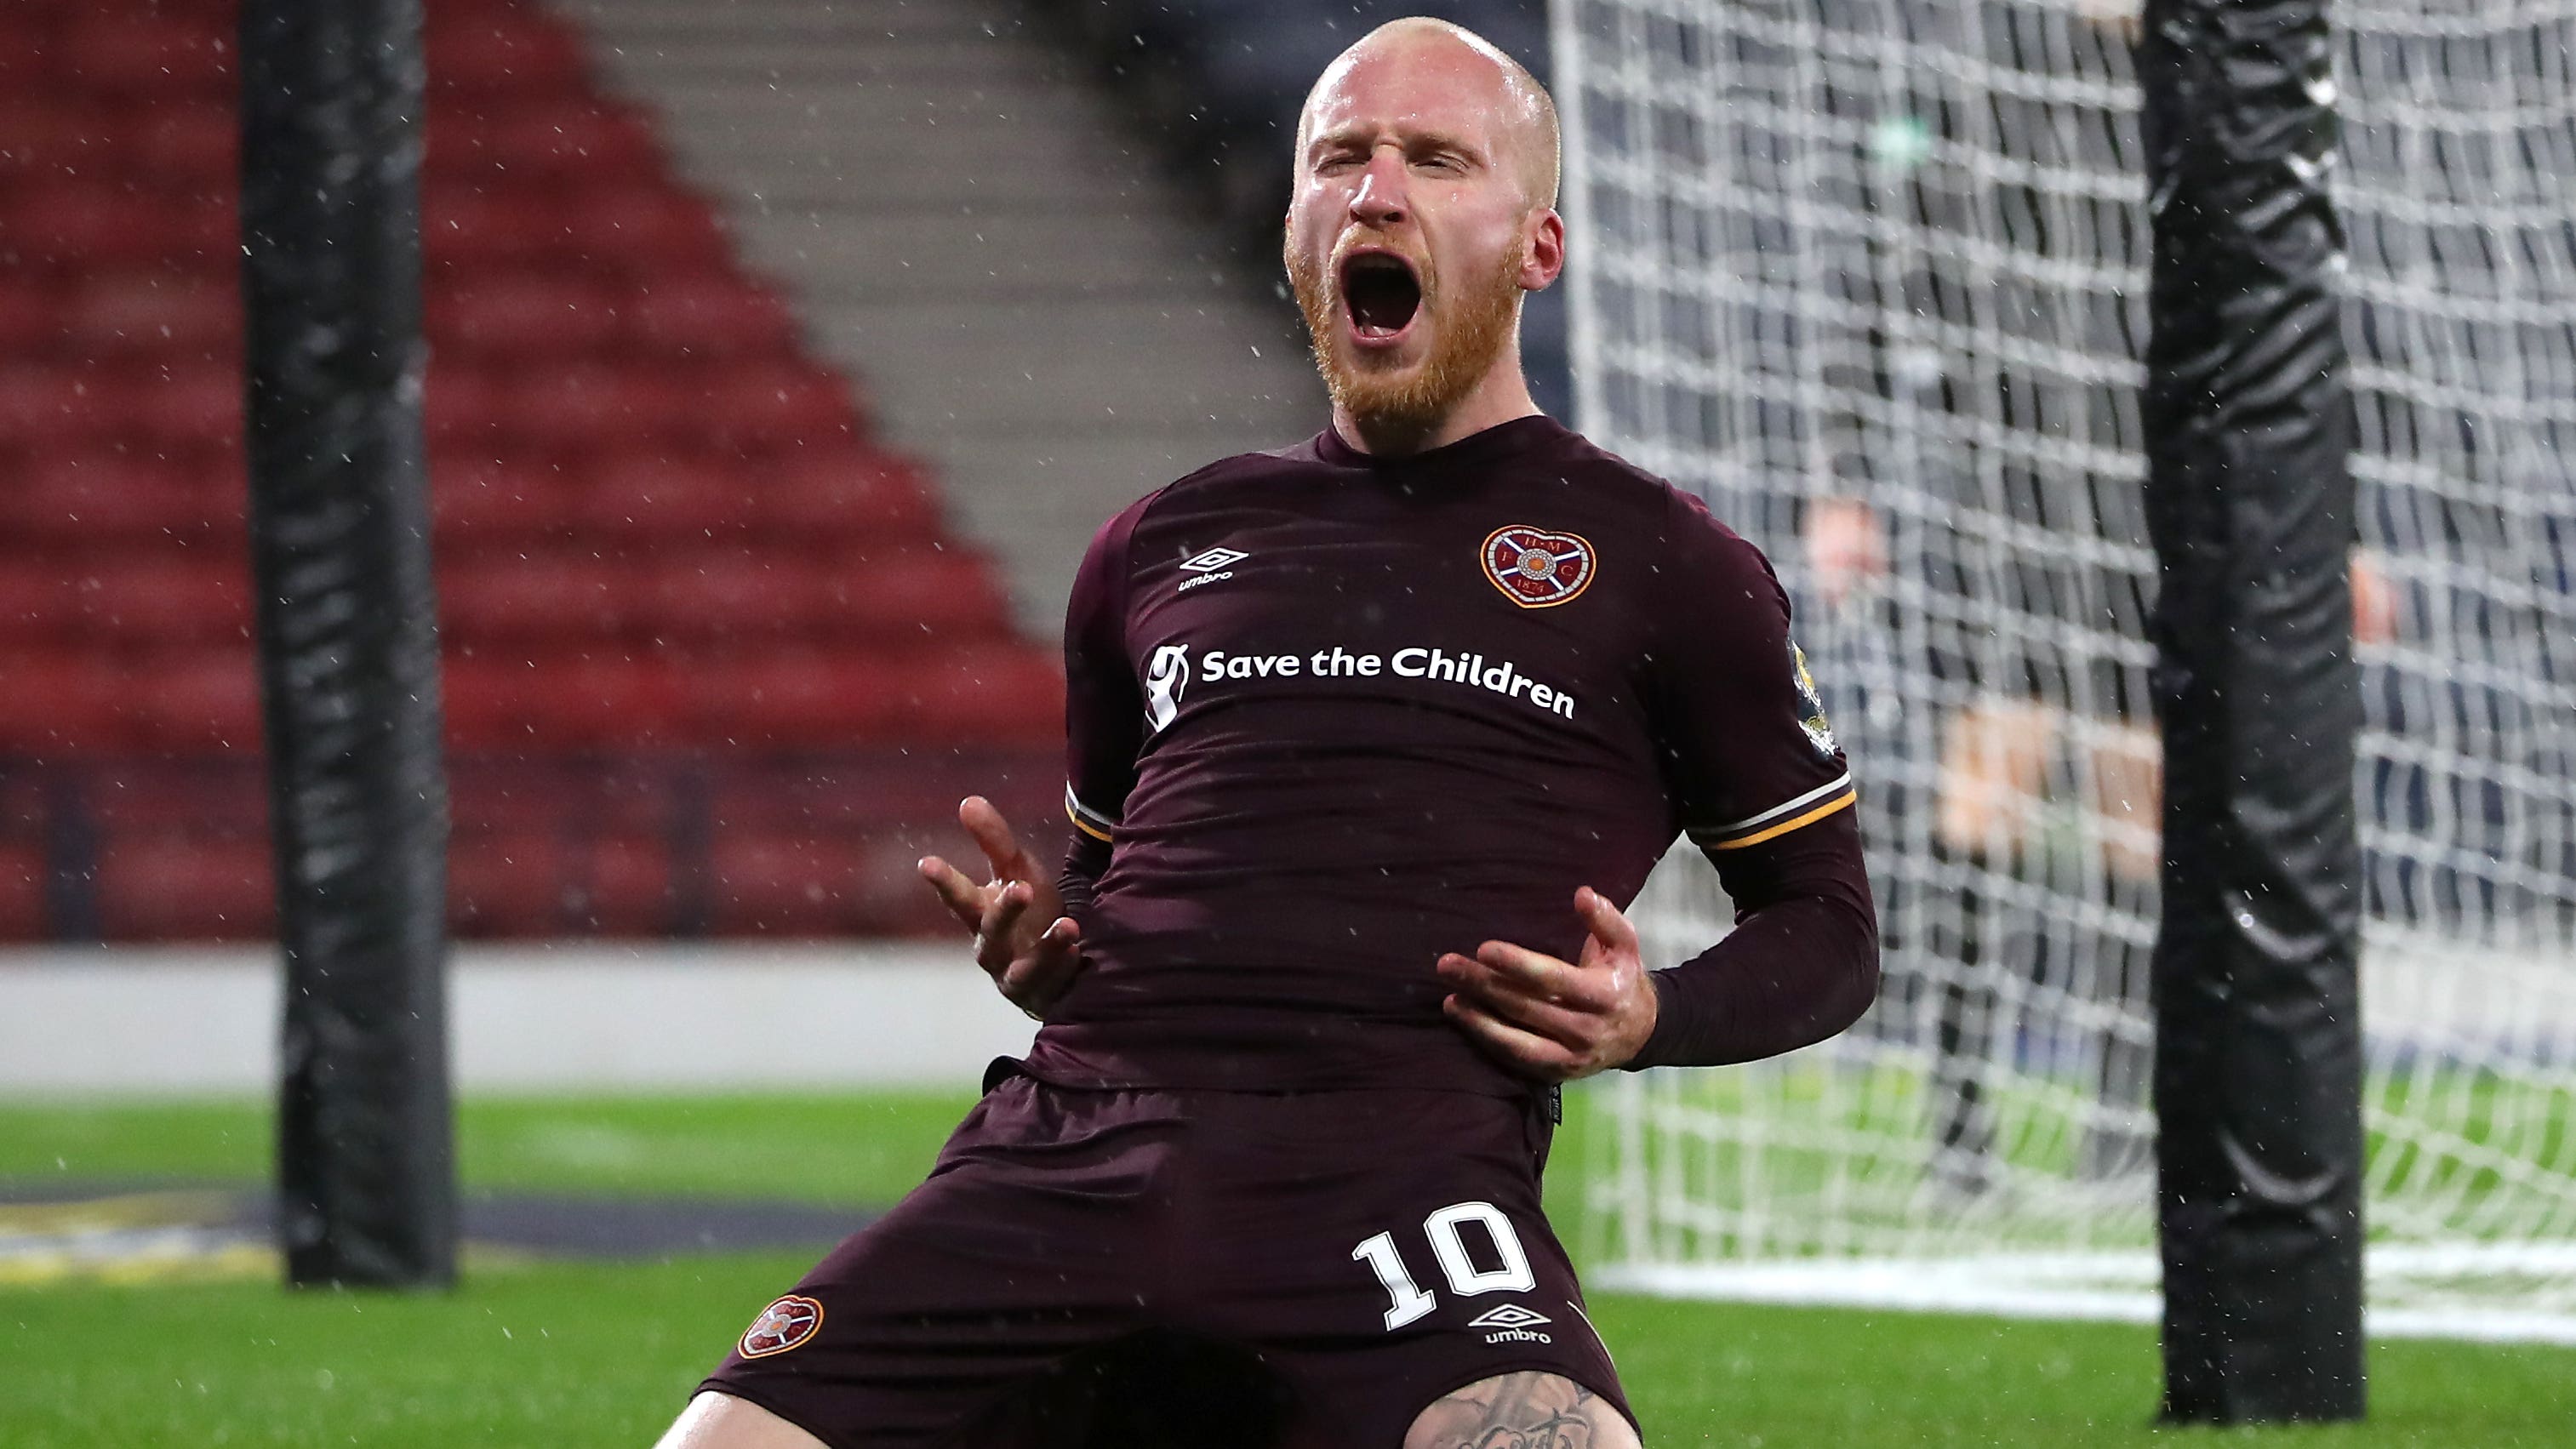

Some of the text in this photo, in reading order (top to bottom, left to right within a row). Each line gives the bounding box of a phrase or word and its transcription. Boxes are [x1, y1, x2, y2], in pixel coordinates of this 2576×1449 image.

[1178, 571, 1233, 591] umbro
[1202, 647, 1575, 720] Save the Children
[1351, 1201, 1537, 1332] 10
[1484, 1327, 1552, 1344] umbro
